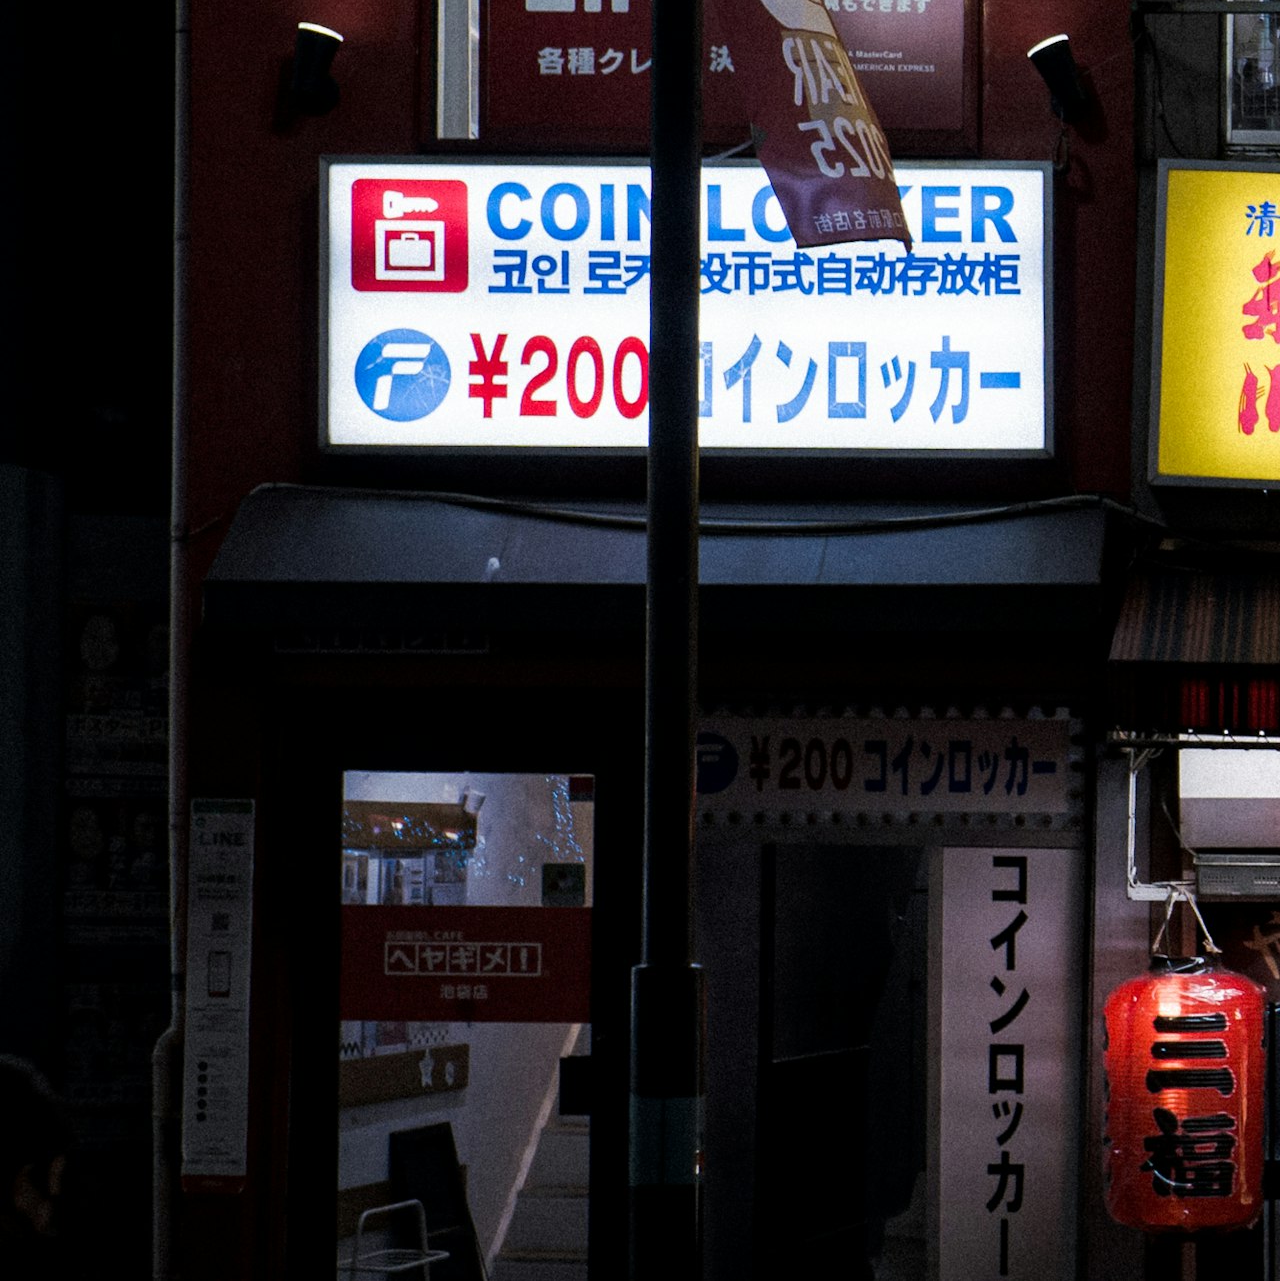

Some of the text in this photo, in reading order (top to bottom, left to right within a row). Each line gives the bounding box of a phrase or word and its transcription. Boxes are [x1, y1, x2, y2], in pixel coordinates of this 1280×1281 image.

[487, 252, 571, 296] 코인
[700, 332, 1022, 425] インロッカー
[749, 735, 1057, 796] ¥200 コインロッカー
[986, 855, 1031, 1276] コインロッカー
[1138, 1011, 1238, 1198] 三福
